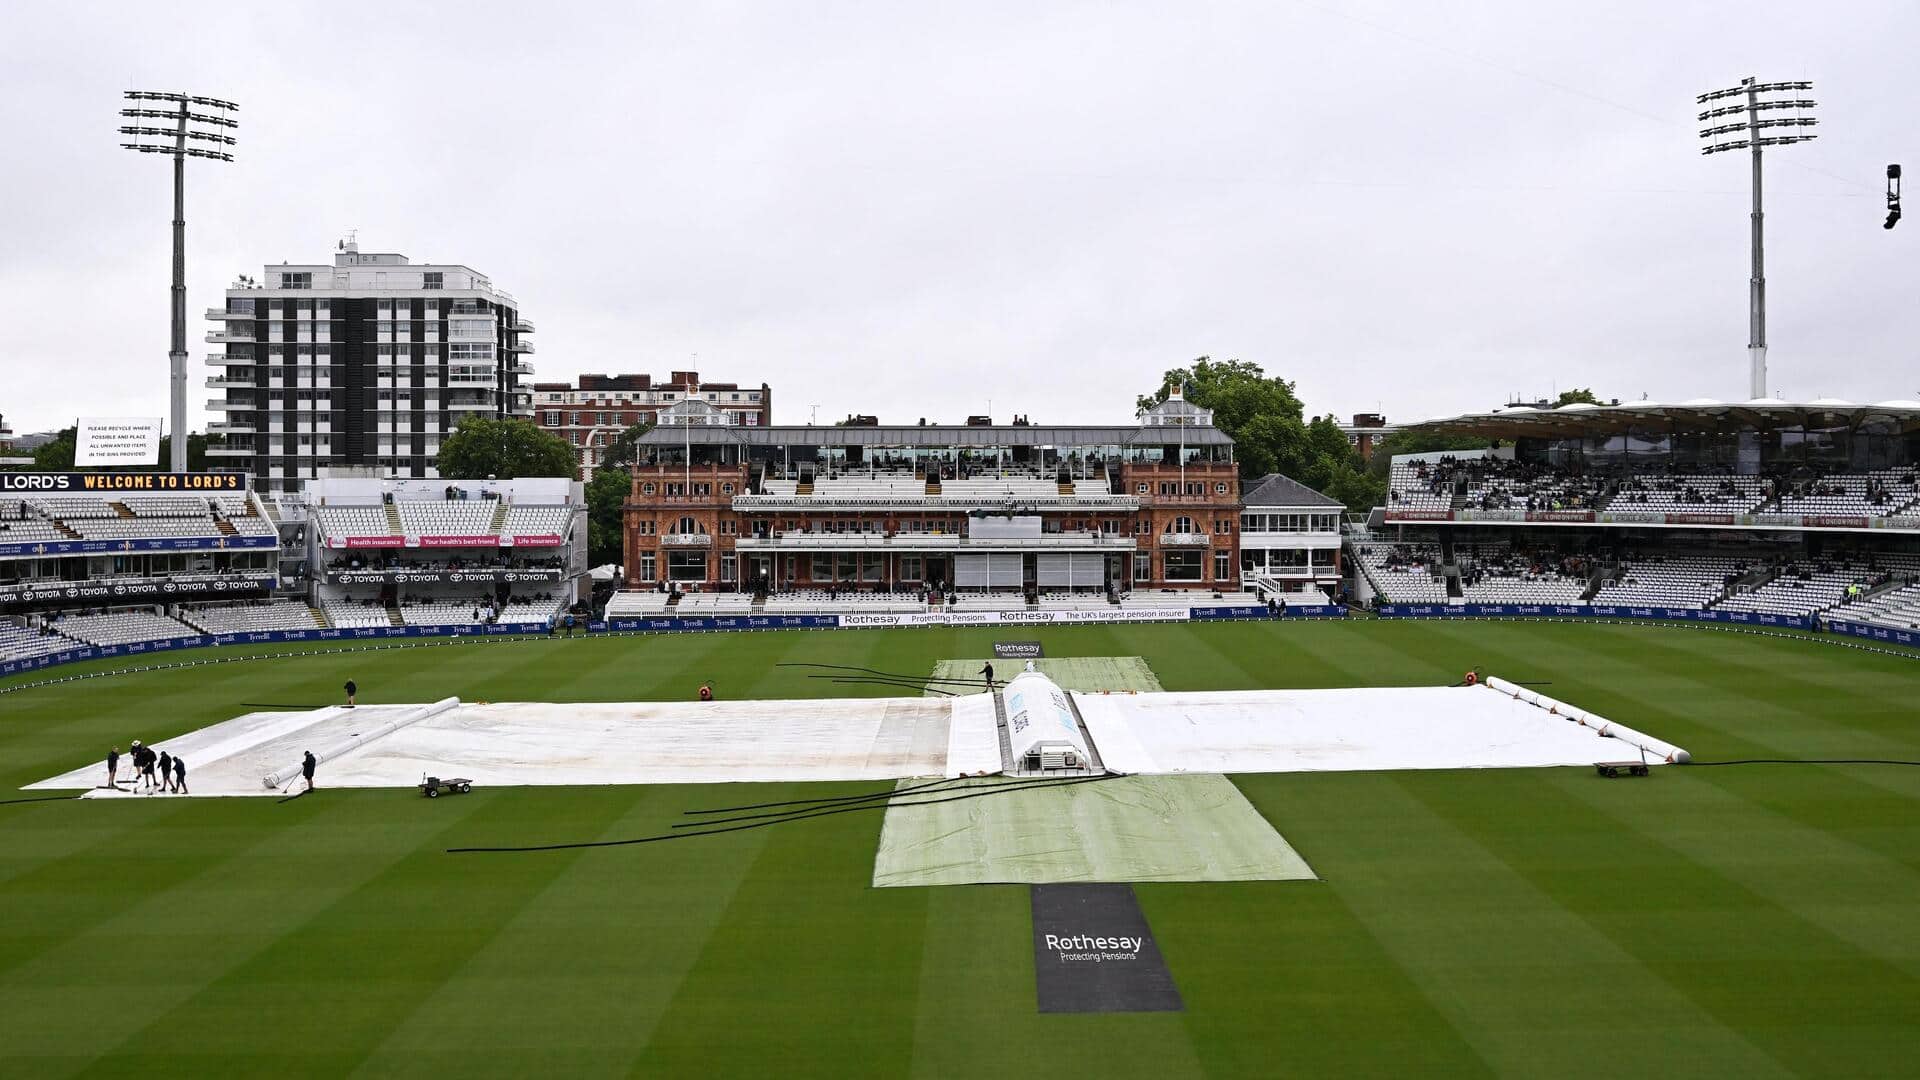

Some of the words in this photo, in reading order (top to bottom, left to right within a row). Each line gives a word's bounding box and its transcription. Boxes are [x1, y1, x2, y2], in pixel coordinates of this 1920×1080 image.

[4, 475, 70, 489] LORD'S
[84, 475, 153, 489] WELCOME
[159, 476, 177, 488] TO
[184, 476, 237, 488] LORD'S
[354, 575, 385, 583] TOYOTA
[410, 574, 440, 582] TOYOTA
[464, 573, 495, 581] TOYOTA
[519, 573, 549, 581] TOYOTA
[128, 585, 157, 593] TOYOTA
[178, 583, 207, 591] TOYOTA
[229, 581, 259, 589] TOYOTA
[35, 590, 60, 599] TOYOTA
[80, 587, 108, 596] TOYOTA
[0, 594, 17, 602] YOTA
[844, 614, 901, 625] Rothesay
[911, 613, 950, 623] Protecting
[952, 613, 986, 622] Pensions
[1000, 611, 1055, 622] Rothesay
[1066, 611, 1080, 619] The
[1081, 611, 1097, 619] UK's
[1099, 610, 1125, 621] largest
[1126, 610, 1157, 621] pension
[1158, 609, 1185, 618] insurer
[995, 644, 1040, 653] Rothesay
[1045, 934, 1142, 953] Rothesay
[1060, 951, 1100, 963] Protecting
[1101, 951, 1137, 961] Pensions
